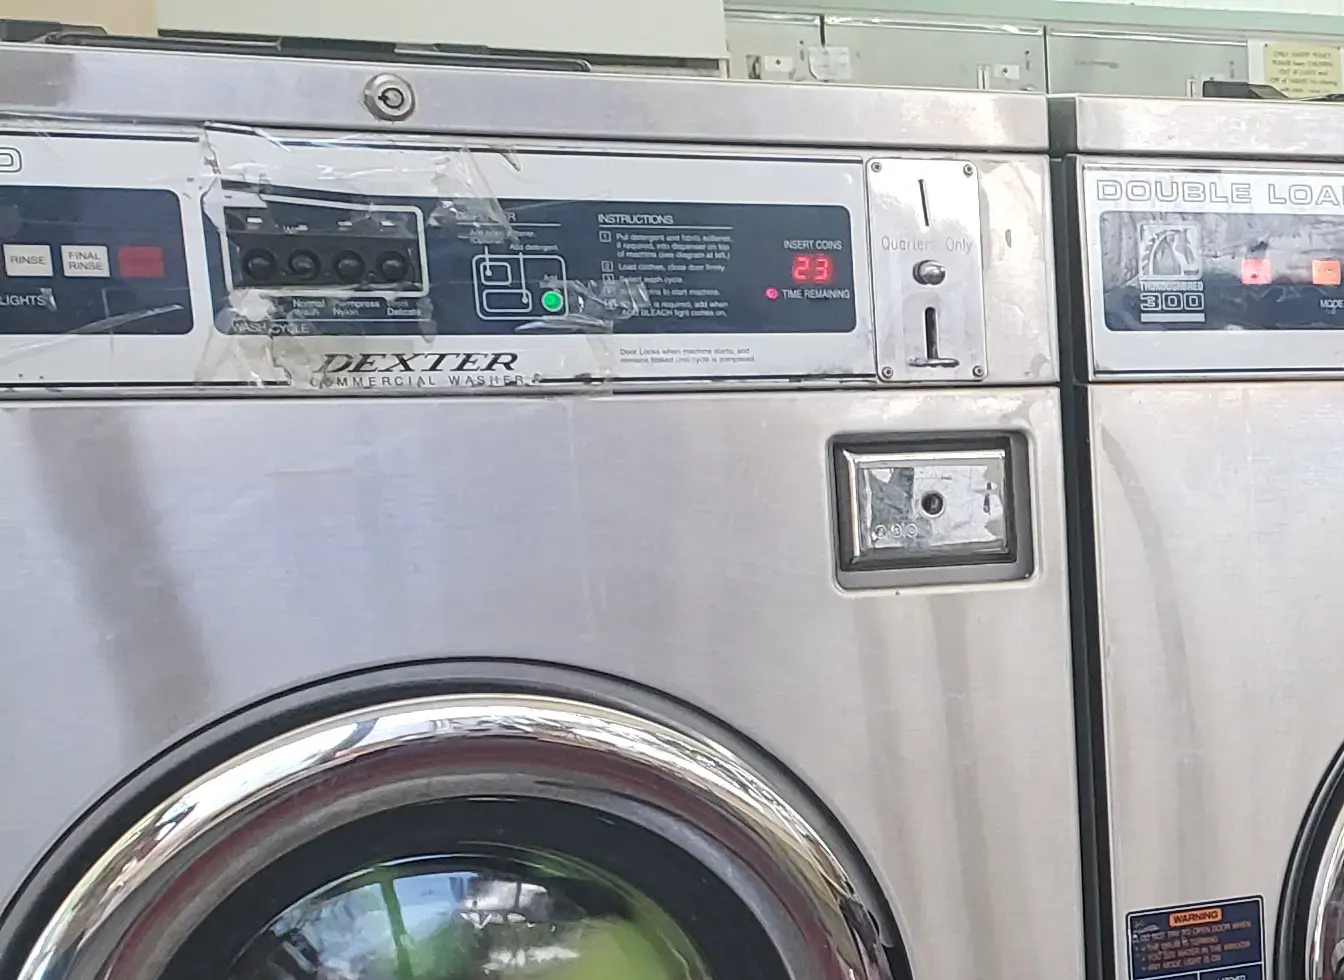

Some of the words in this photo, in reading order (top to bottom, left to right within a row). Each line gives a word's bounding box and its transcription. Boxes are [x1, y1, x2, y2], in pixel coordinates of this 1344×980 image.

[1097, 180, 1252, 204] DOUBLE
[598, 214, 674, 224] INSTRUCTIONS
[784, 240, 814, 249] INSERT
[815, 240, 842, 250] COINS
[881, 236, 936, 251] Quarters
[946, 236, 973, 254] Only
[10, 256, 46, 265] RINSE
[68, 251, 101, 260] FINAL
[68, 261, 104, 270] RINSE
[793, 256, 829, 281] 23
[781, 290, 803, 299] TIME
[804, 290, 850, 299] REMAINING
[1140, 292, 1204, 311] 300
[1320, 299, 1344, 308] MODE
[233, 321, 266, 332] WASH
[313, 352, 518, 373] DEXTER
[310, 375, 435, 389] COMMERCIAL
[449, 375, 523, 387] WASHER
[1173, 910, 1219, 924] WARNING
